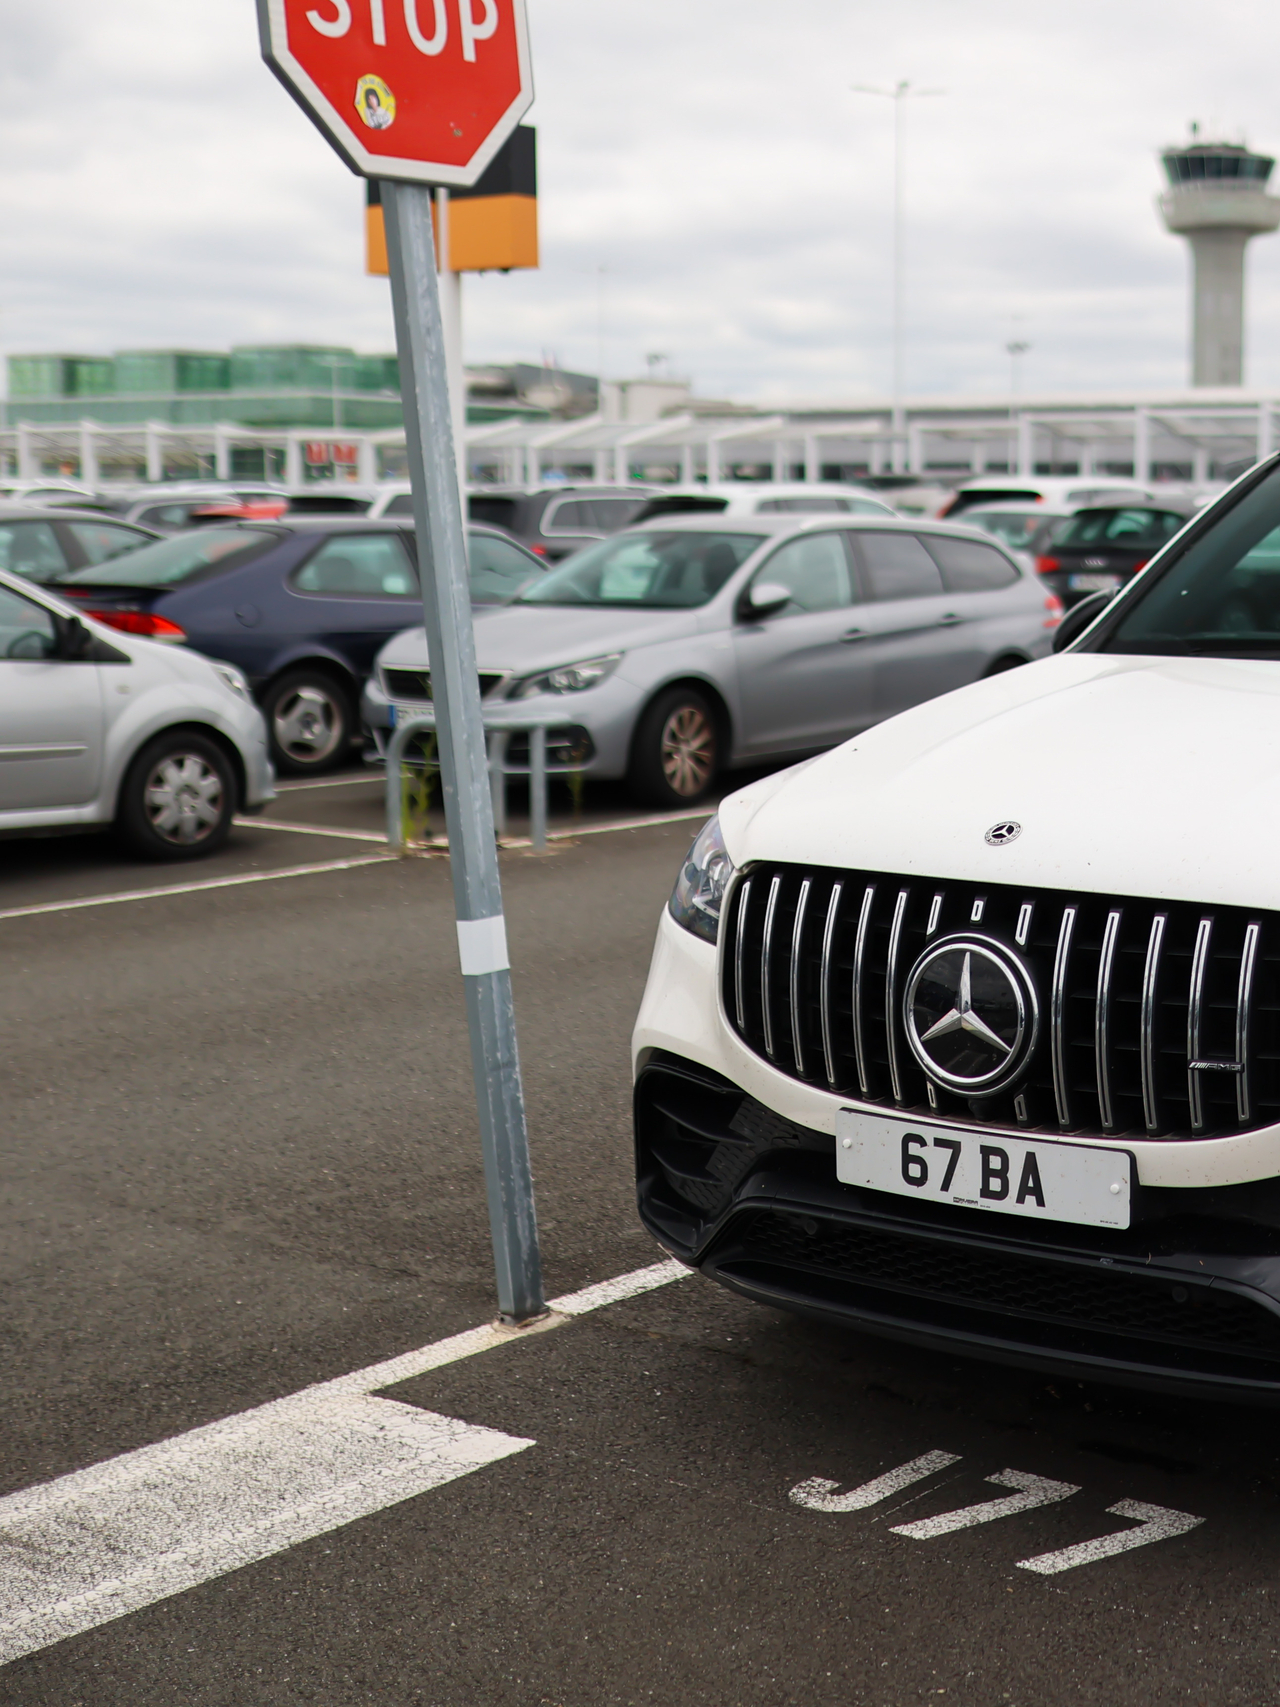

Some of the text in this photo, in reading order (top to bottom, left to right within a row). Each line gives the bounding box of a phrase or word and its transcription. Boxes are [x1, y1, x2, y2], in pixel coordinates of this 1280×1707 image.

[901, 1132, 1046, 1208] 67 BA
[788, 1449, 1207, 1575] J77
